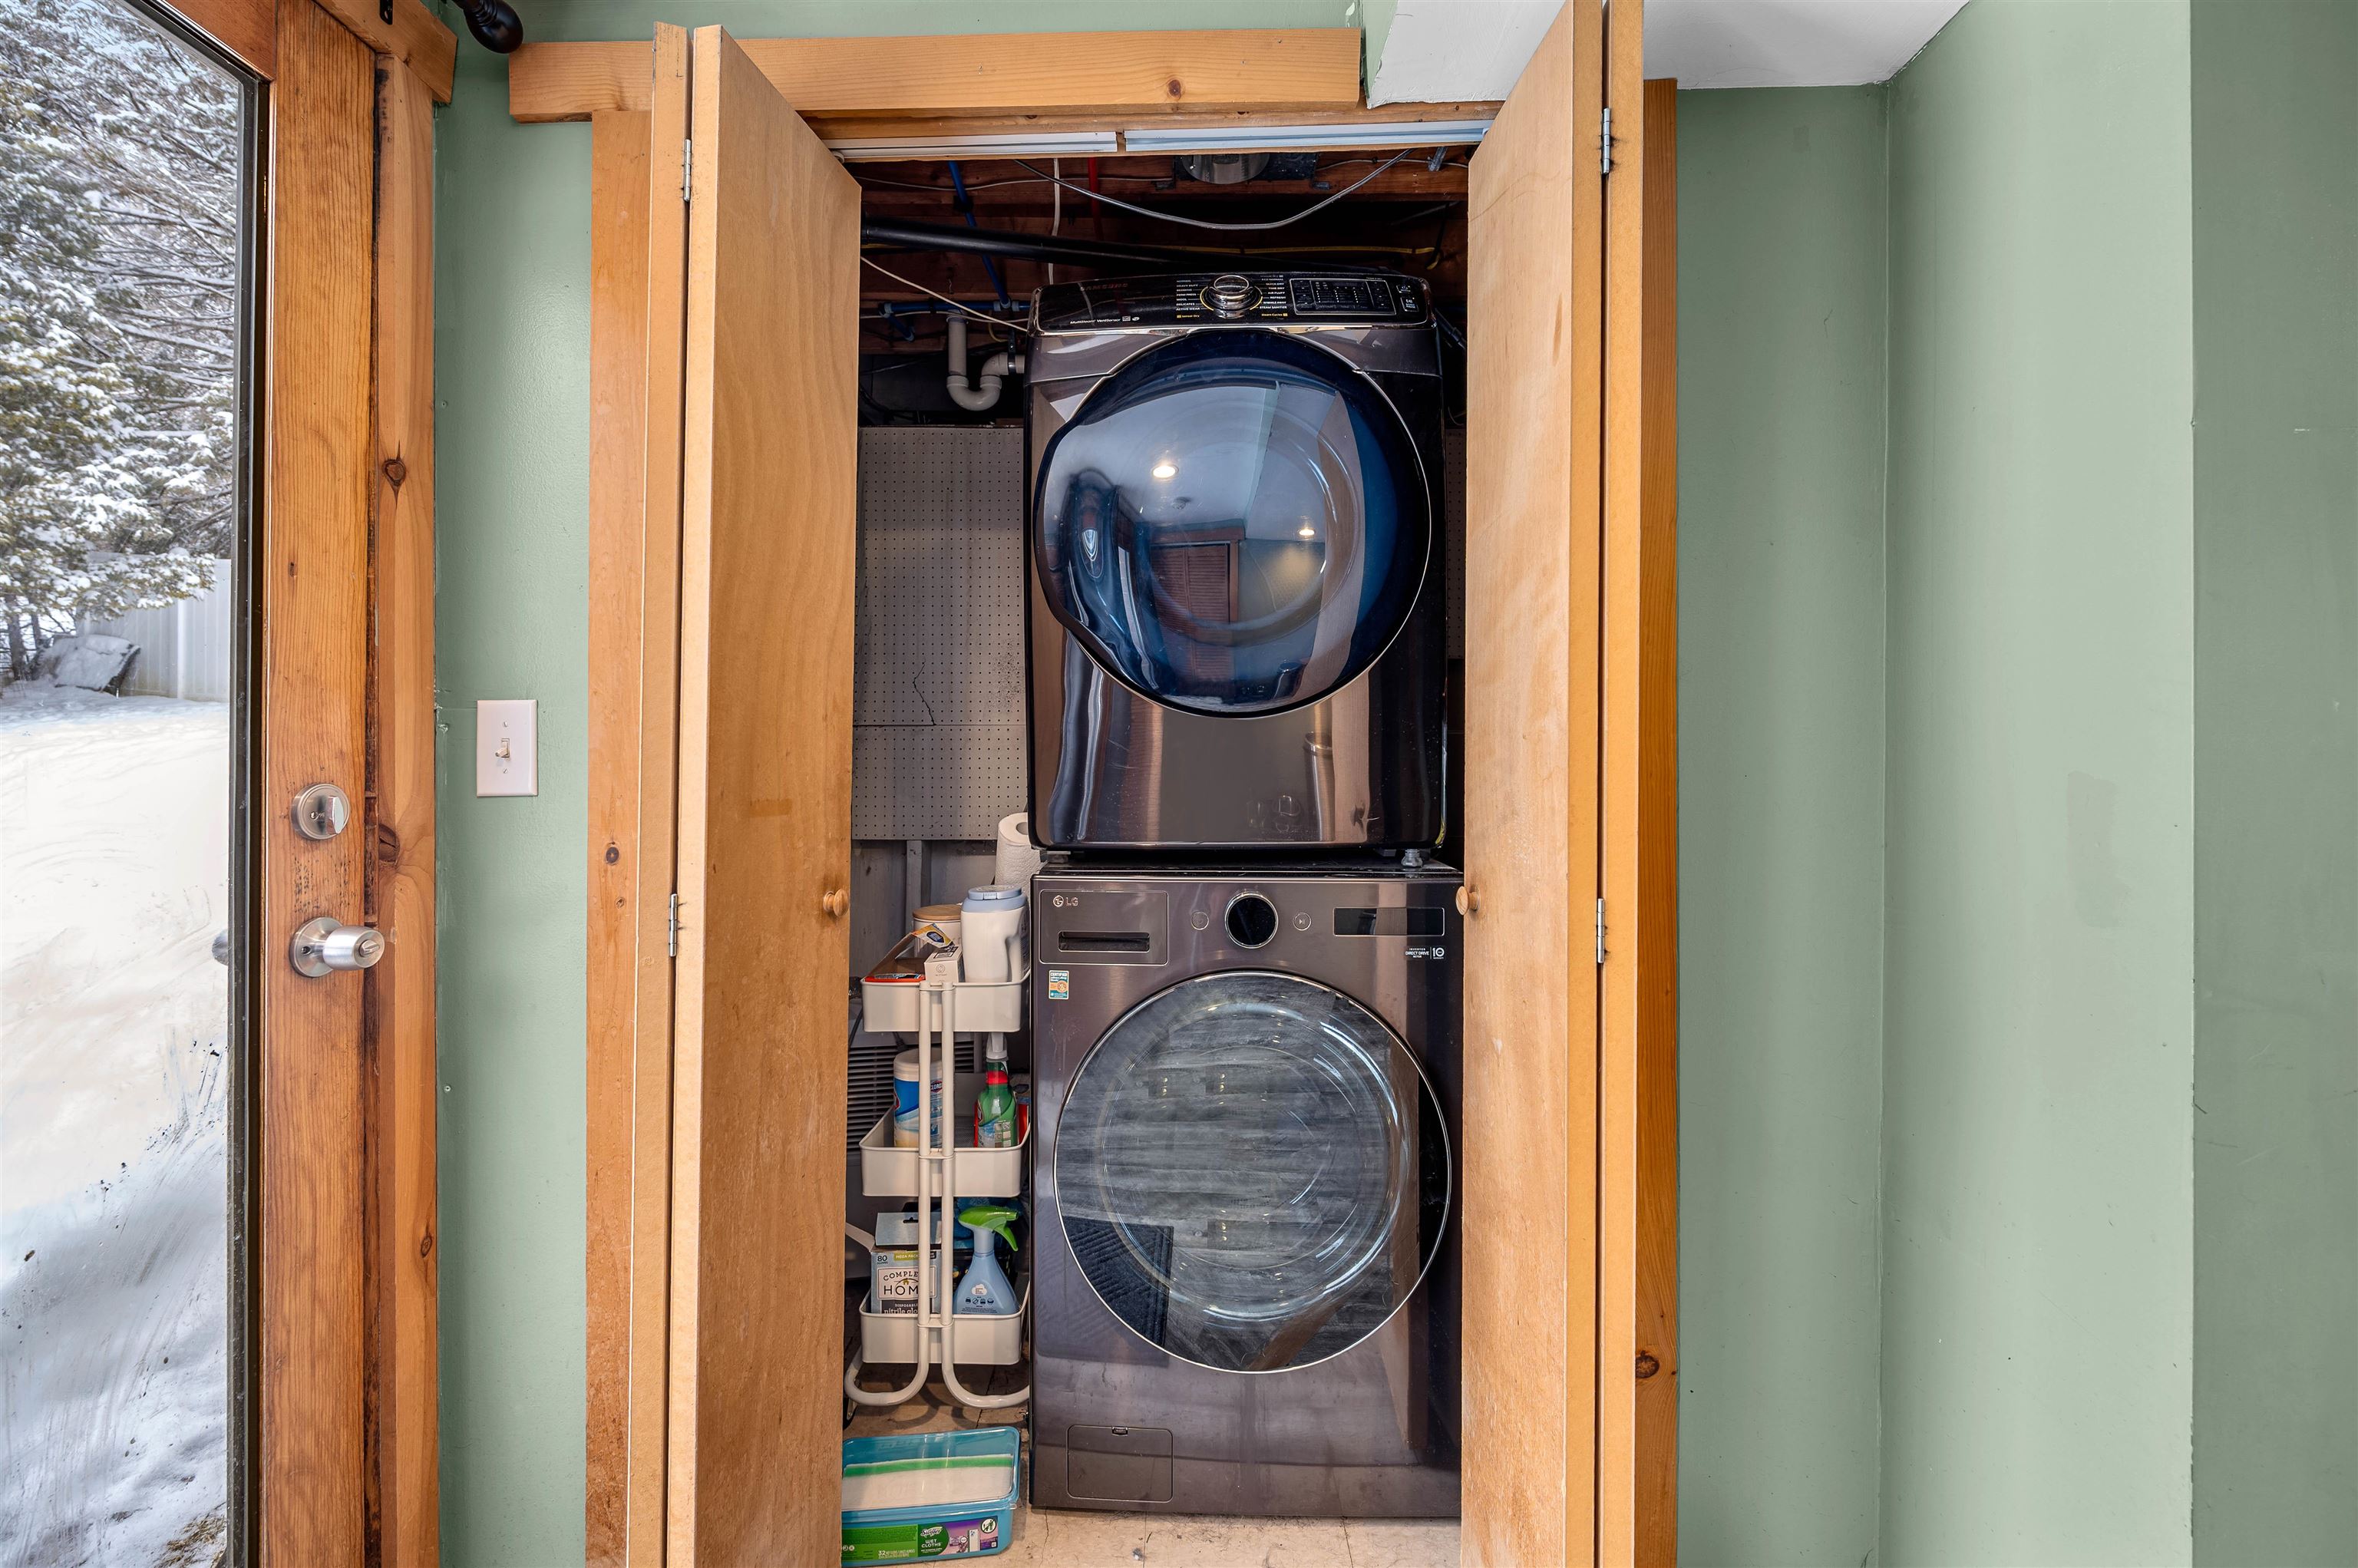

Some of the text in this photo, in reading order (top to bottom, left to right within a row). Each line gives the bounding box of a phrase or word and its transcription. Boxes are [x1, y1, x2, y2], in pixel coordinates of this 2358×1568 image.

[1065, 896, 1078, 906] LG
[883, 1271, 919, 1281] COMPLE
[883, 1285, 918, 1296] HOM
[920, 1528, 941, 1537] Swiffer
